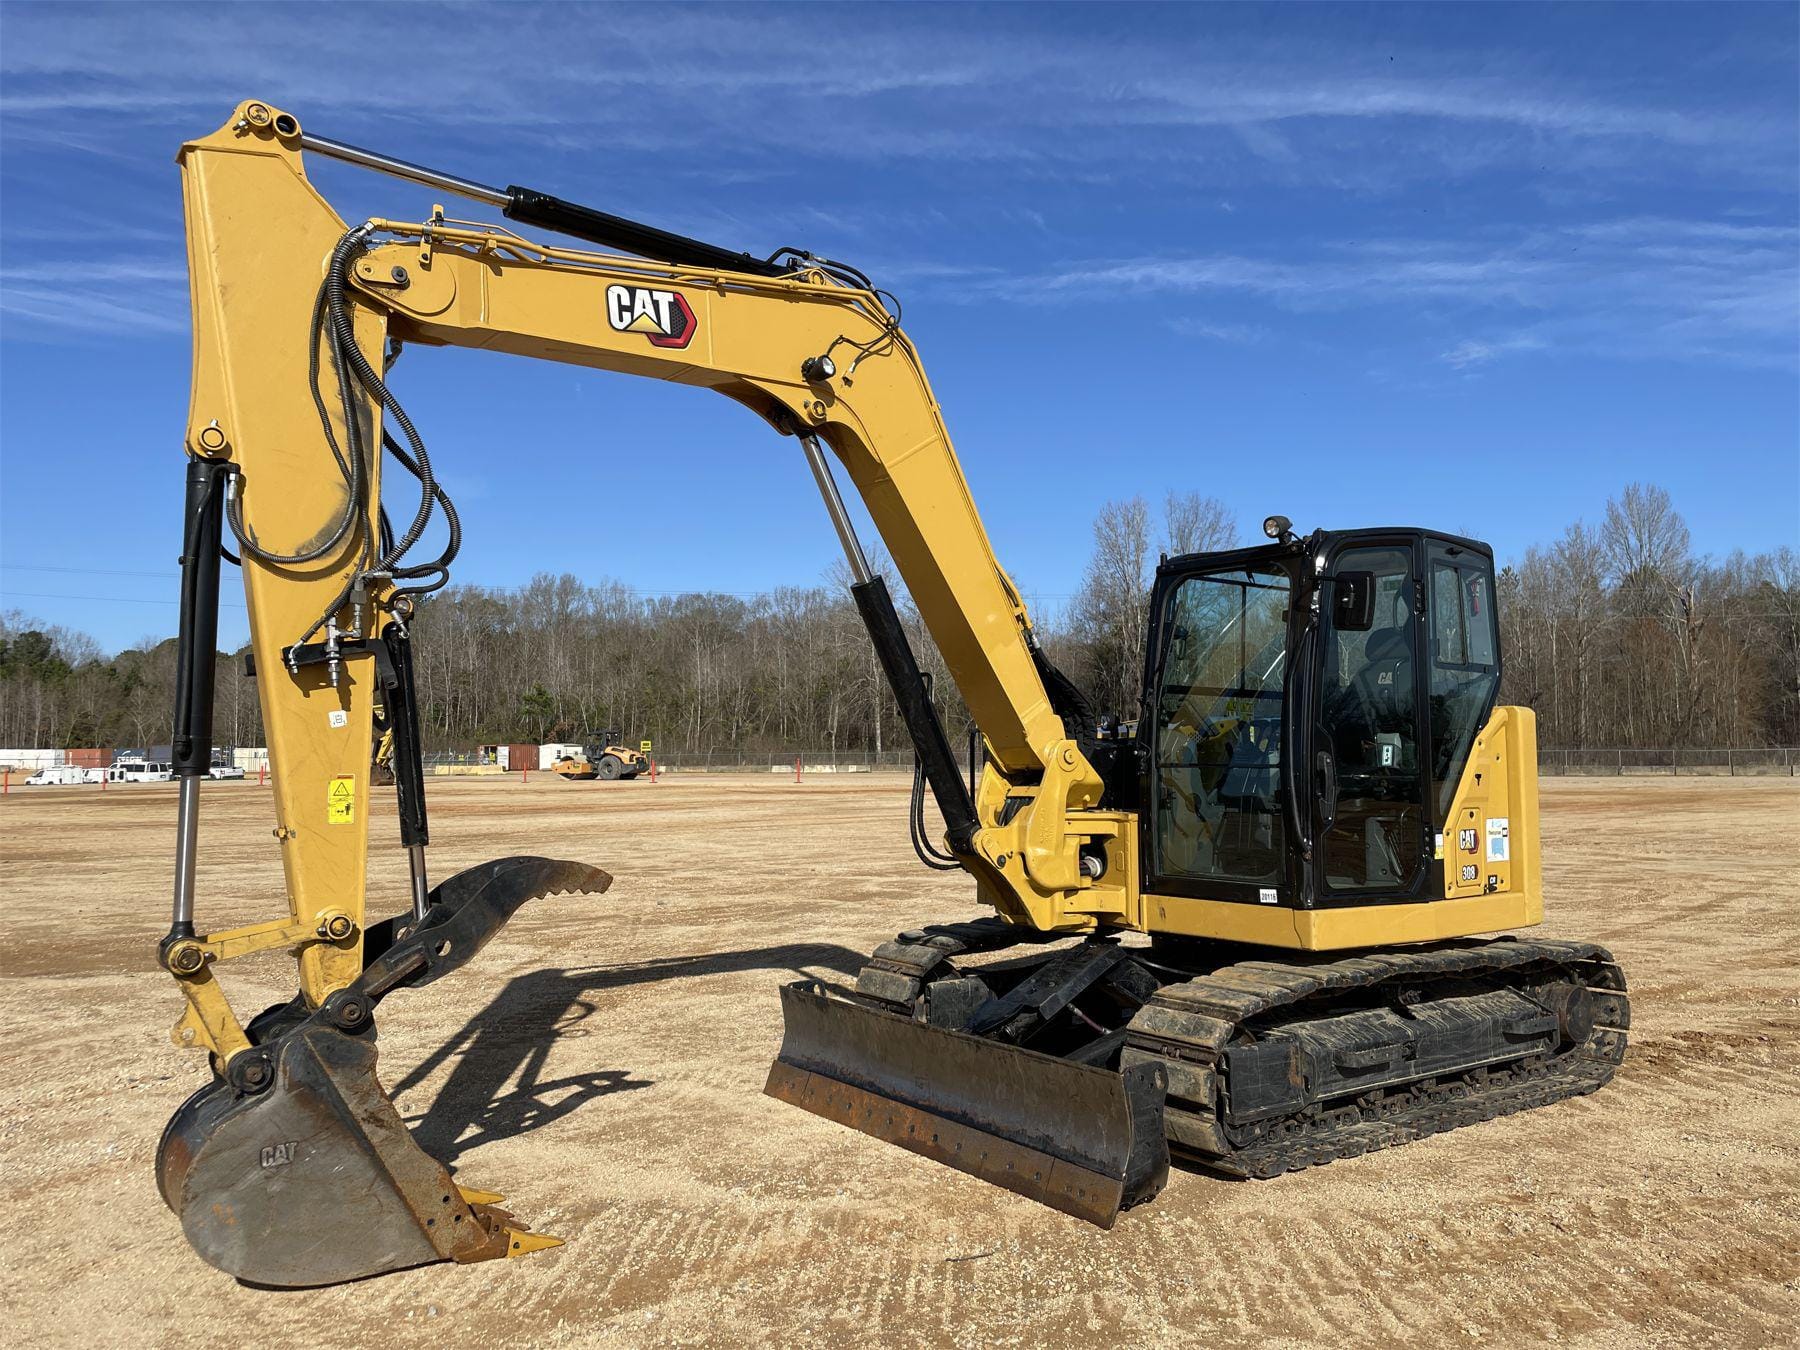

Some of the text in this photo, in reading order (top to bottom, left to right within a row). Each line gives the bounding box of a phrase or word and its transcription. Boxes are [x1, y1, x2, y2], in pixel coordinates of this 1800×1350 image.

[607, 285, 675, 335] CAT
[1377, 671, 1393, 685] CA
[1460, 829, 1476, 850] CAT
[1462, 865, 1476, 880] 308
[261, 1141, 299, 1169] CAT
